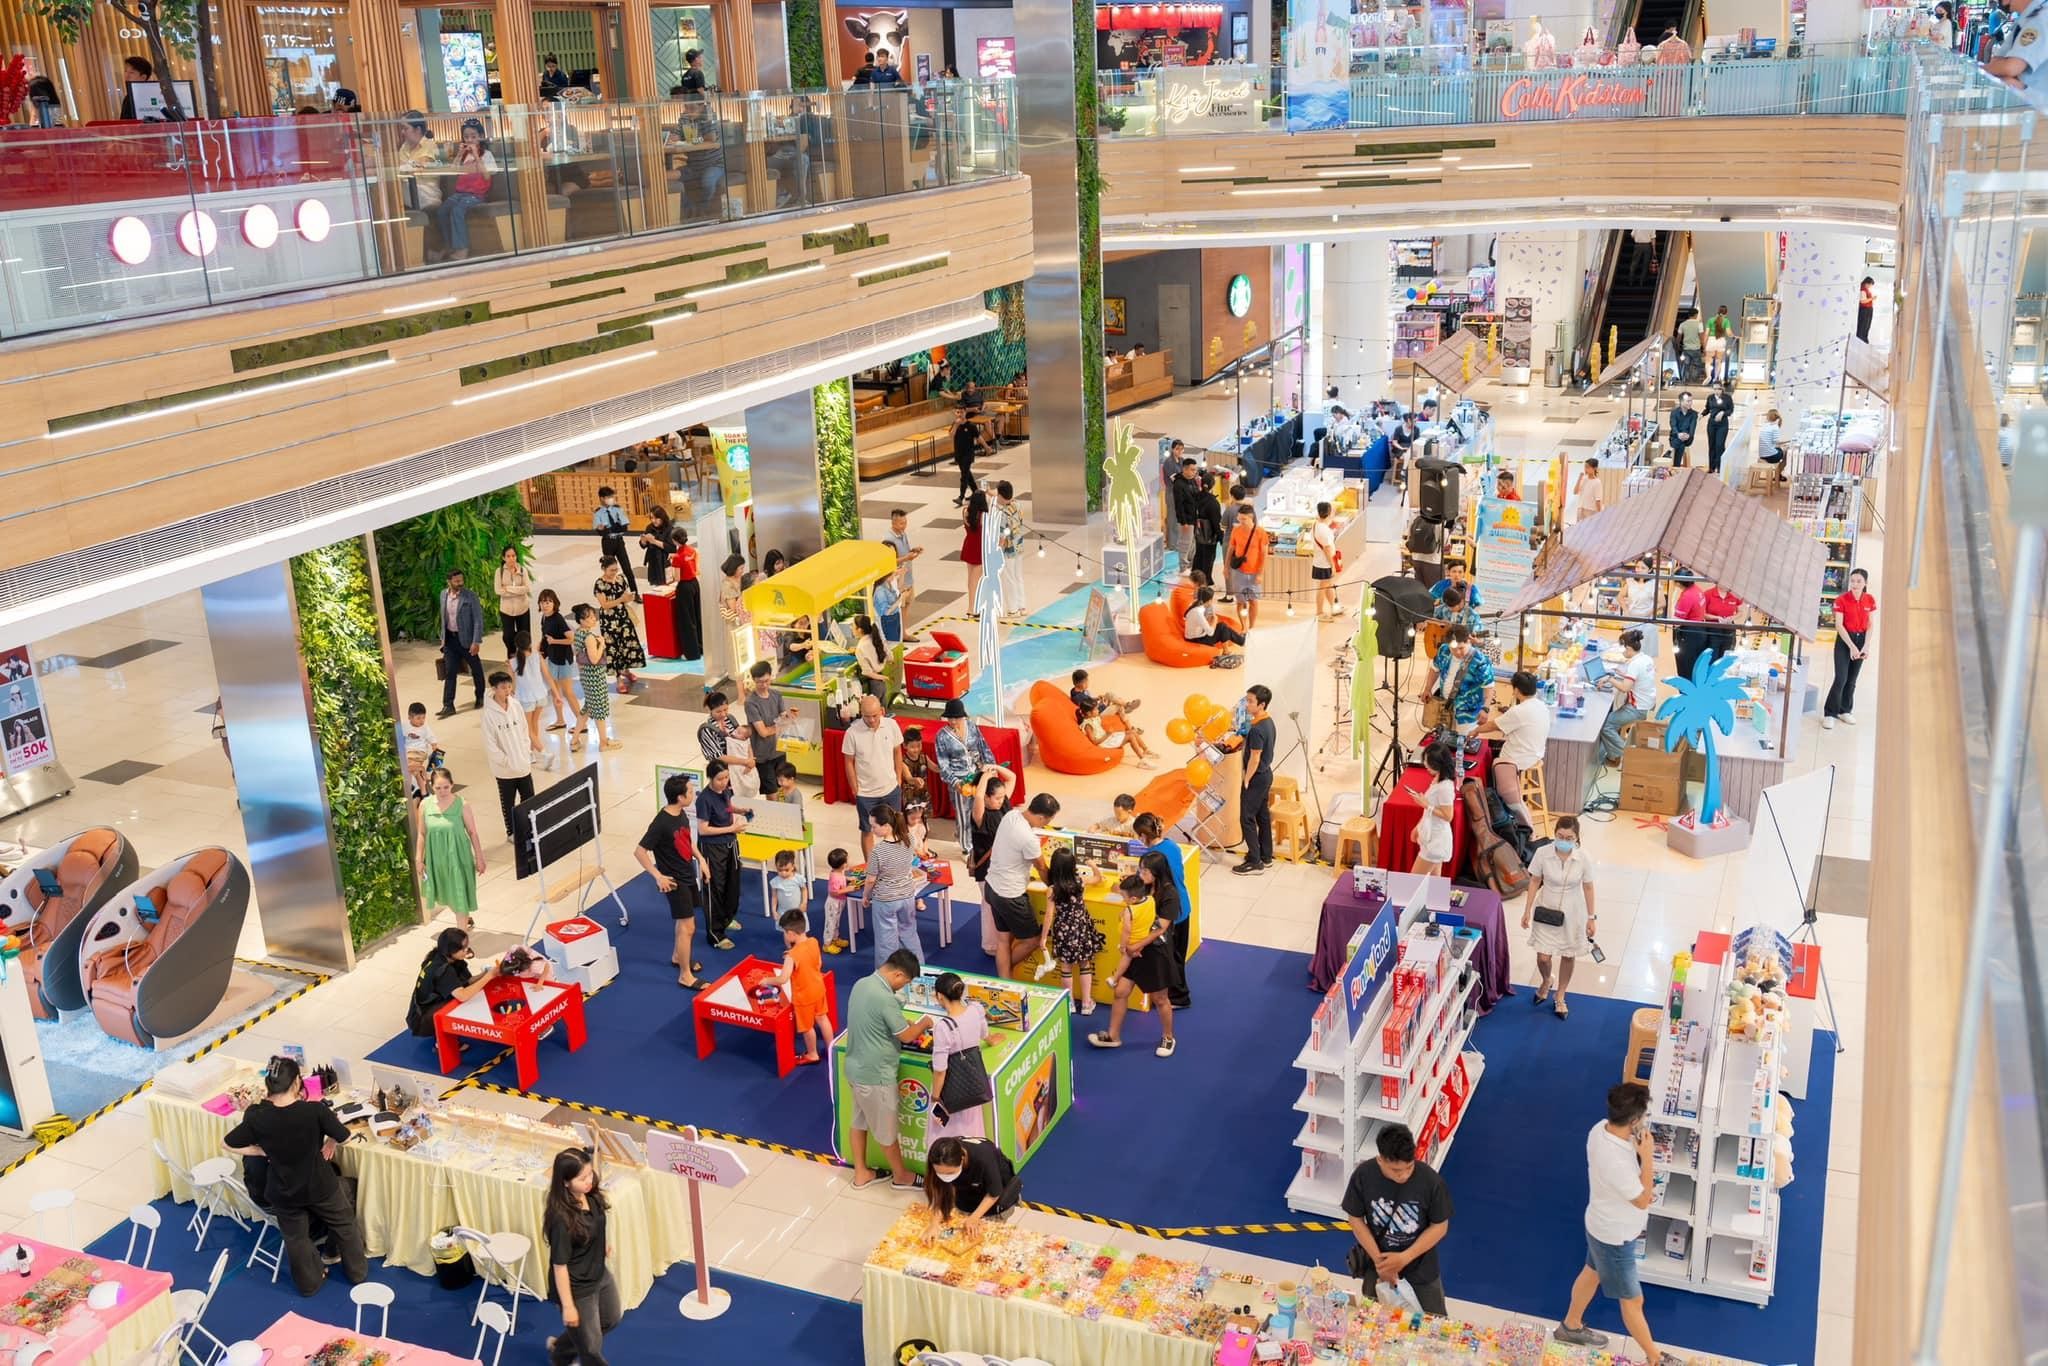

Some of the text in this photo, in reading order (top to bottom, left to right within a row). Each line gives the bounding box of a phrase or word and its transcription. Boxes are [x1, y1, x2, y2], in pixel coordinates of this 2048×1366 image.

[1501, 76, 1644, 118] Cath Kidston
[1211, 103, 1234, 113] Fine
[23, 740, 48, 758] 50K
[529, 999, 568, 1033] SMARTMAX
[710, 1008, 763, 1026] SMARTMAX
[451, 1022, 503, 1039] SMARTMAX
[1005, 1055, 1031, 1096] COME
[1038, 1017, 1063, 1056] PLAY!
[915, 1117, 928, 1128] G
[898, 1133, 918, 1150] lay
